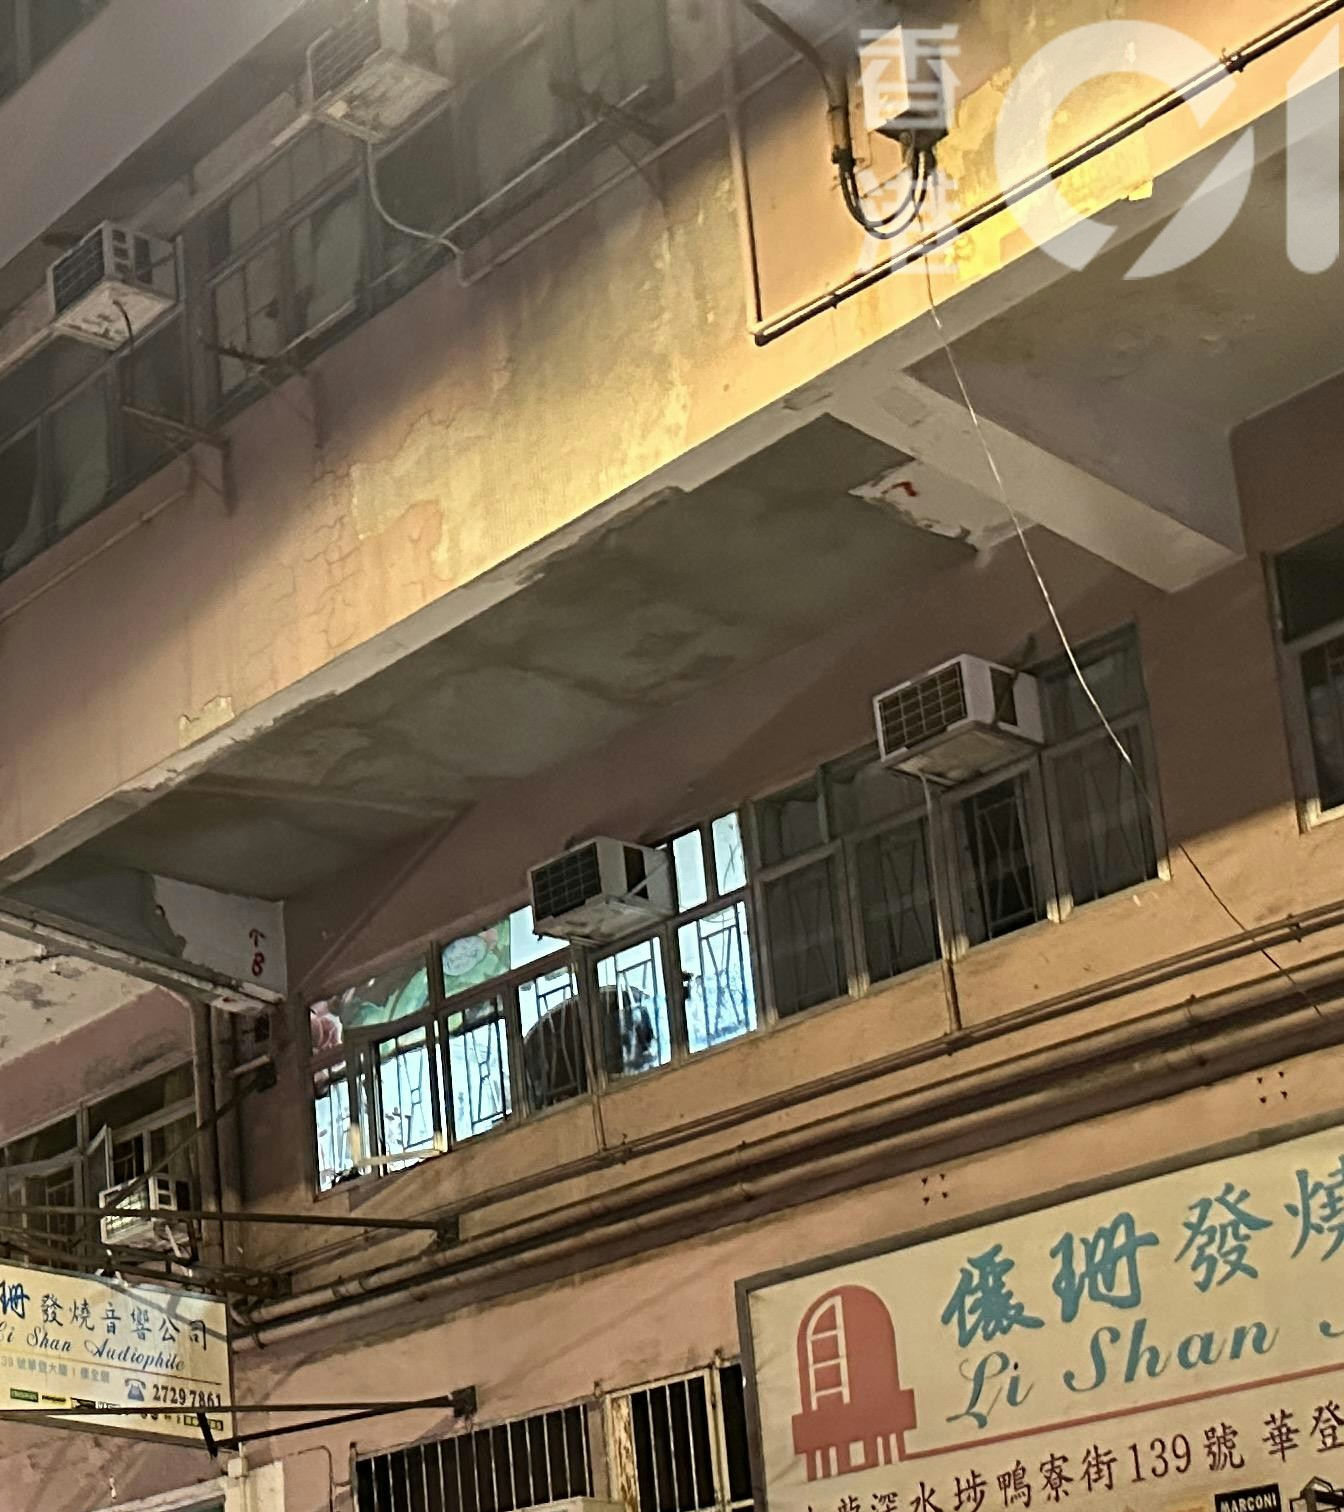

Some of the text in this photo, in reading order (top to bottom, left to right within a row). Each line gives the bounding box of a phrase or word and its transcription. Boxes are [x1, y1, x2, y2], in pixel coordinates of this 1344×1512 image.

[26, 1325, 71, 1352] Shan
[84, 1338, 185, 1371] Audiophile
[946, 1318, 1280, 1429] Li Shan
